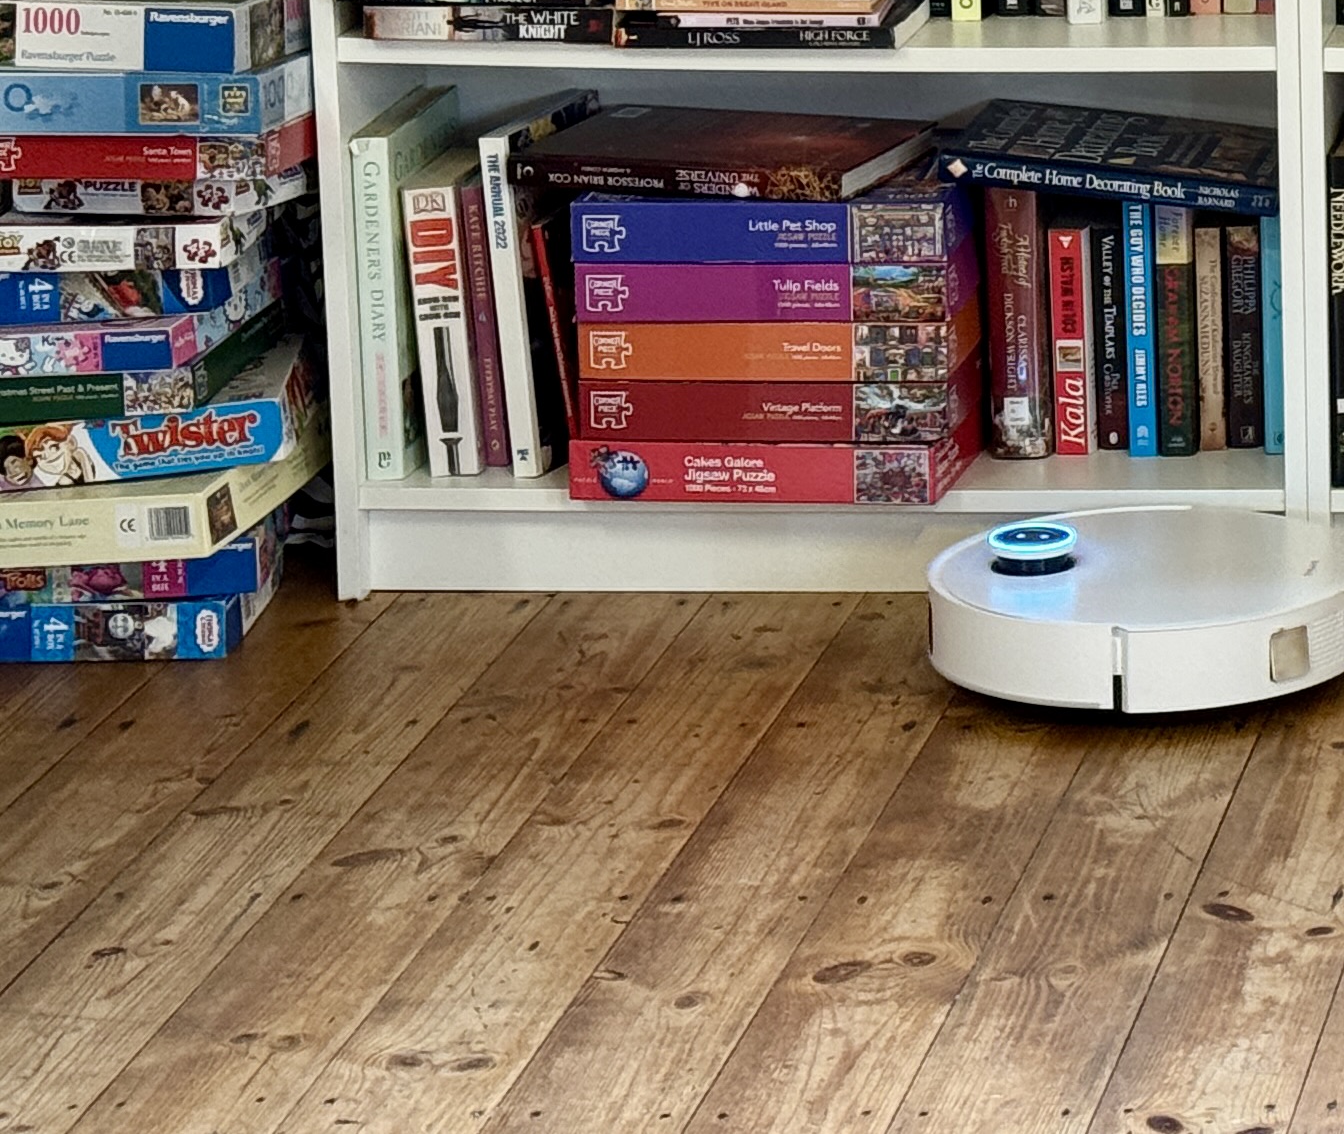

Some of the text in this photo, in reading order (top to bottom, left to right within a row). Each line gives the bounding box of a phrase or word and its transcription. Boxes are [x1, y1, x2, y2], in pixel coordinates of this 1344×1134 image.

[22, 7, 80, 35] 1000
[150, 12, 229, 26] Ravensburger
[505, 11, 579, 25] THE WHITE
[519, 25, 567, 39] KNIGHT
[984, 162, 1186, 200] Complete Home Decorating Book
[487, 154, 508, 250] THE ANNUAL 2022
[748, 220, 836, 234] Little Pet Shop
[363, 161, 386, 342] GARDENER'S DIARY
[409, 218, 459, 291] DIY
[1129, 204, 1146, 336] THE GUY WHO DECIDES
[772, 280, 839, 293] Tulip Fields
[110, 410, 260, 458] Twister
[684, 456, 764, 468] Cakes Galore
[684, 469, 776, 483] Jigsaw Puzzle
